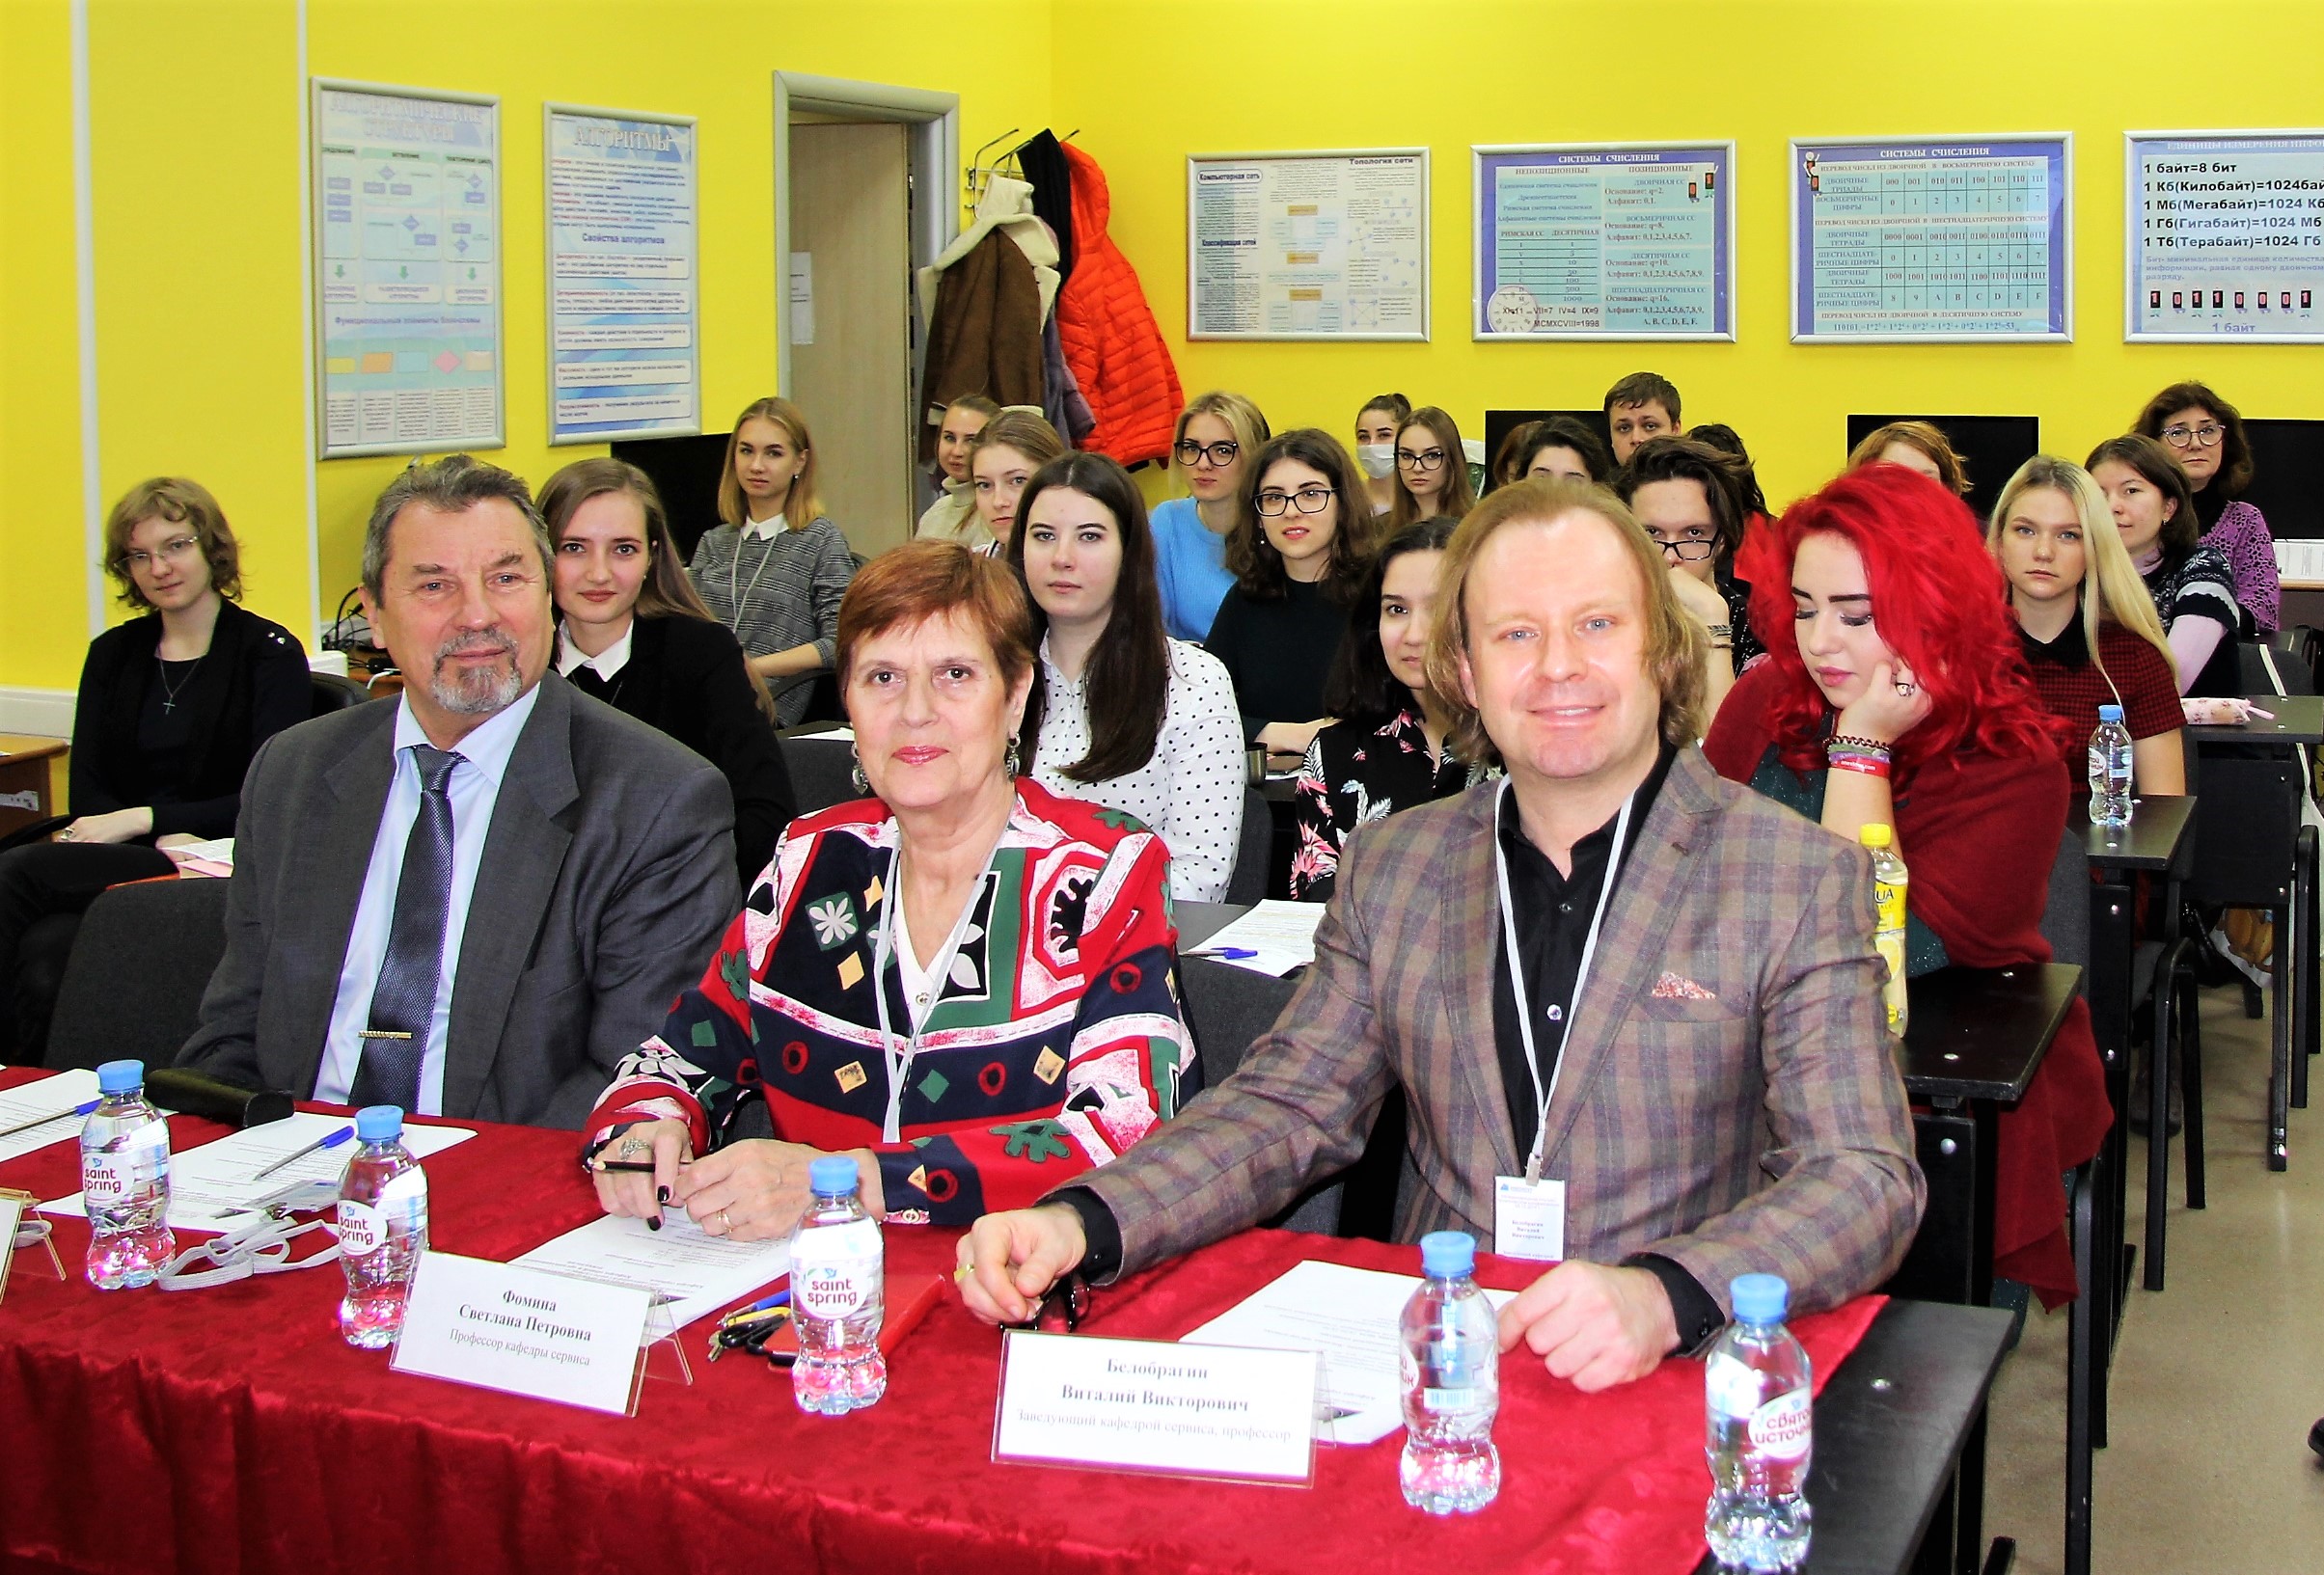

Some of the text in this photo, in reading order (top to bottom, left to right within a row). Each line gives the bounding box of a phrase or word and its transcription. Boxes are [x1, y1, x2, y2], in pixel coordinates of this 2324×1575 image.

[574, 126, 672, 151] АЛГОРИТМЫ
[1931, 148, 1989, 157] СЧИСЛЕНИЯ
[2144, 162, 2236, 174] 1 байт=8 бит
[2144, 181, 2150, 192] 1
[2144, 200, 2150, 210] 1
[2157, 198, 2303, 211] Мб(Мегабайт)=1024
[2144, 216, 2322, 231] 1 Гб(Гигабайт)=1024 Мб
[2144, 235, 2321, 249] 1 Тб(Терабайт)=1024 Гб
[2212, 322, 2256, 333] 1 байт
[85, 1168, 116, 1180] saint
[811, 1278, 852, 1291] saint
[503, 1290, 557, 1312] Фомина
[807, 1291, 857, 1307] spring
[459, 1303, 591, 1342] Светлана Петровна
[450, 1328, 590, 1366] Профессор кафедры сервиса
[1107, 1358, 1208, 1379] Белобрагин
[1062, 1384, 1248, 1412] Виталий Викторович
[1017, 1408, 1291, 1443] Заведующий кафедрой сервиса, профессор
